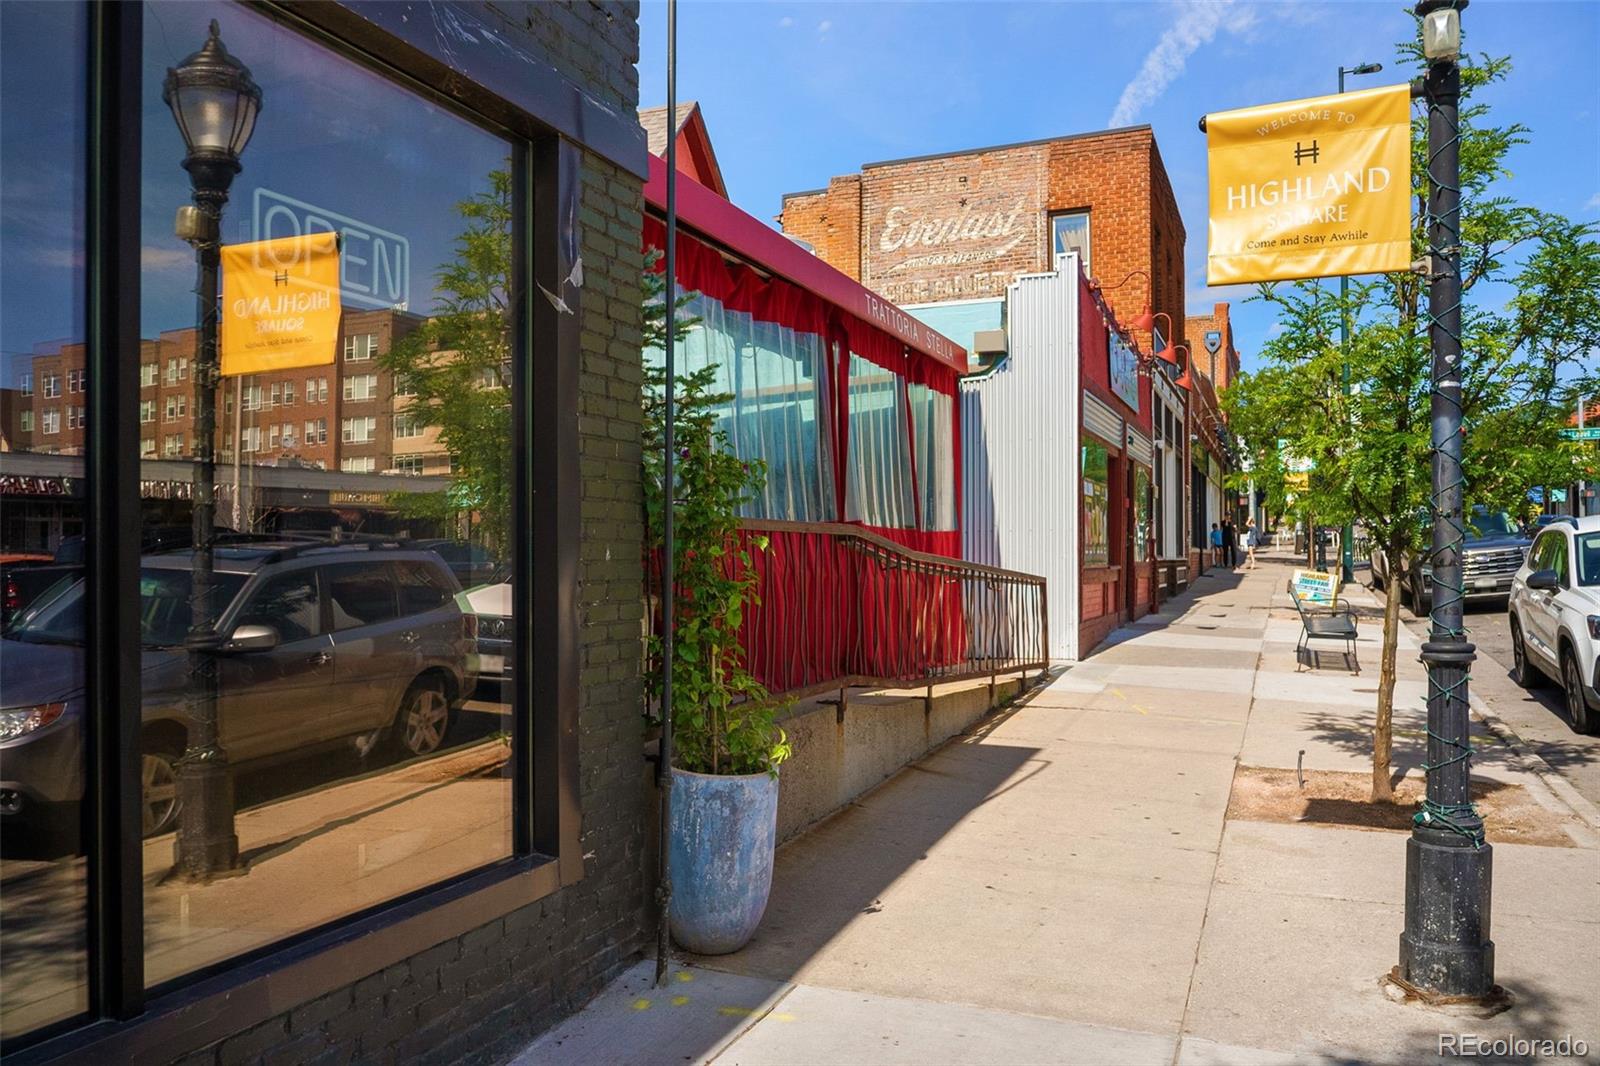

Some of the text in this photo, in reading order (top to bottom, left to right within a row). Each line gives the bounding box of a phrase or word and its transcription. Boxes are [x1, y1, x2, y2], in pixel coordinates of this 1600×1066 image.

[1256, 109, 1356, 137] WELCOME TO
[1227, 167, 1391, 211] HIGHLAND
[1267, 204, 1348, 230] SQUARE
[264, 204, 401, 300] OPEN
[1246, 230, 1369, 250] Come and Stay Awhile
[864, 294, 954, 362] TRATTORIA STELLA
